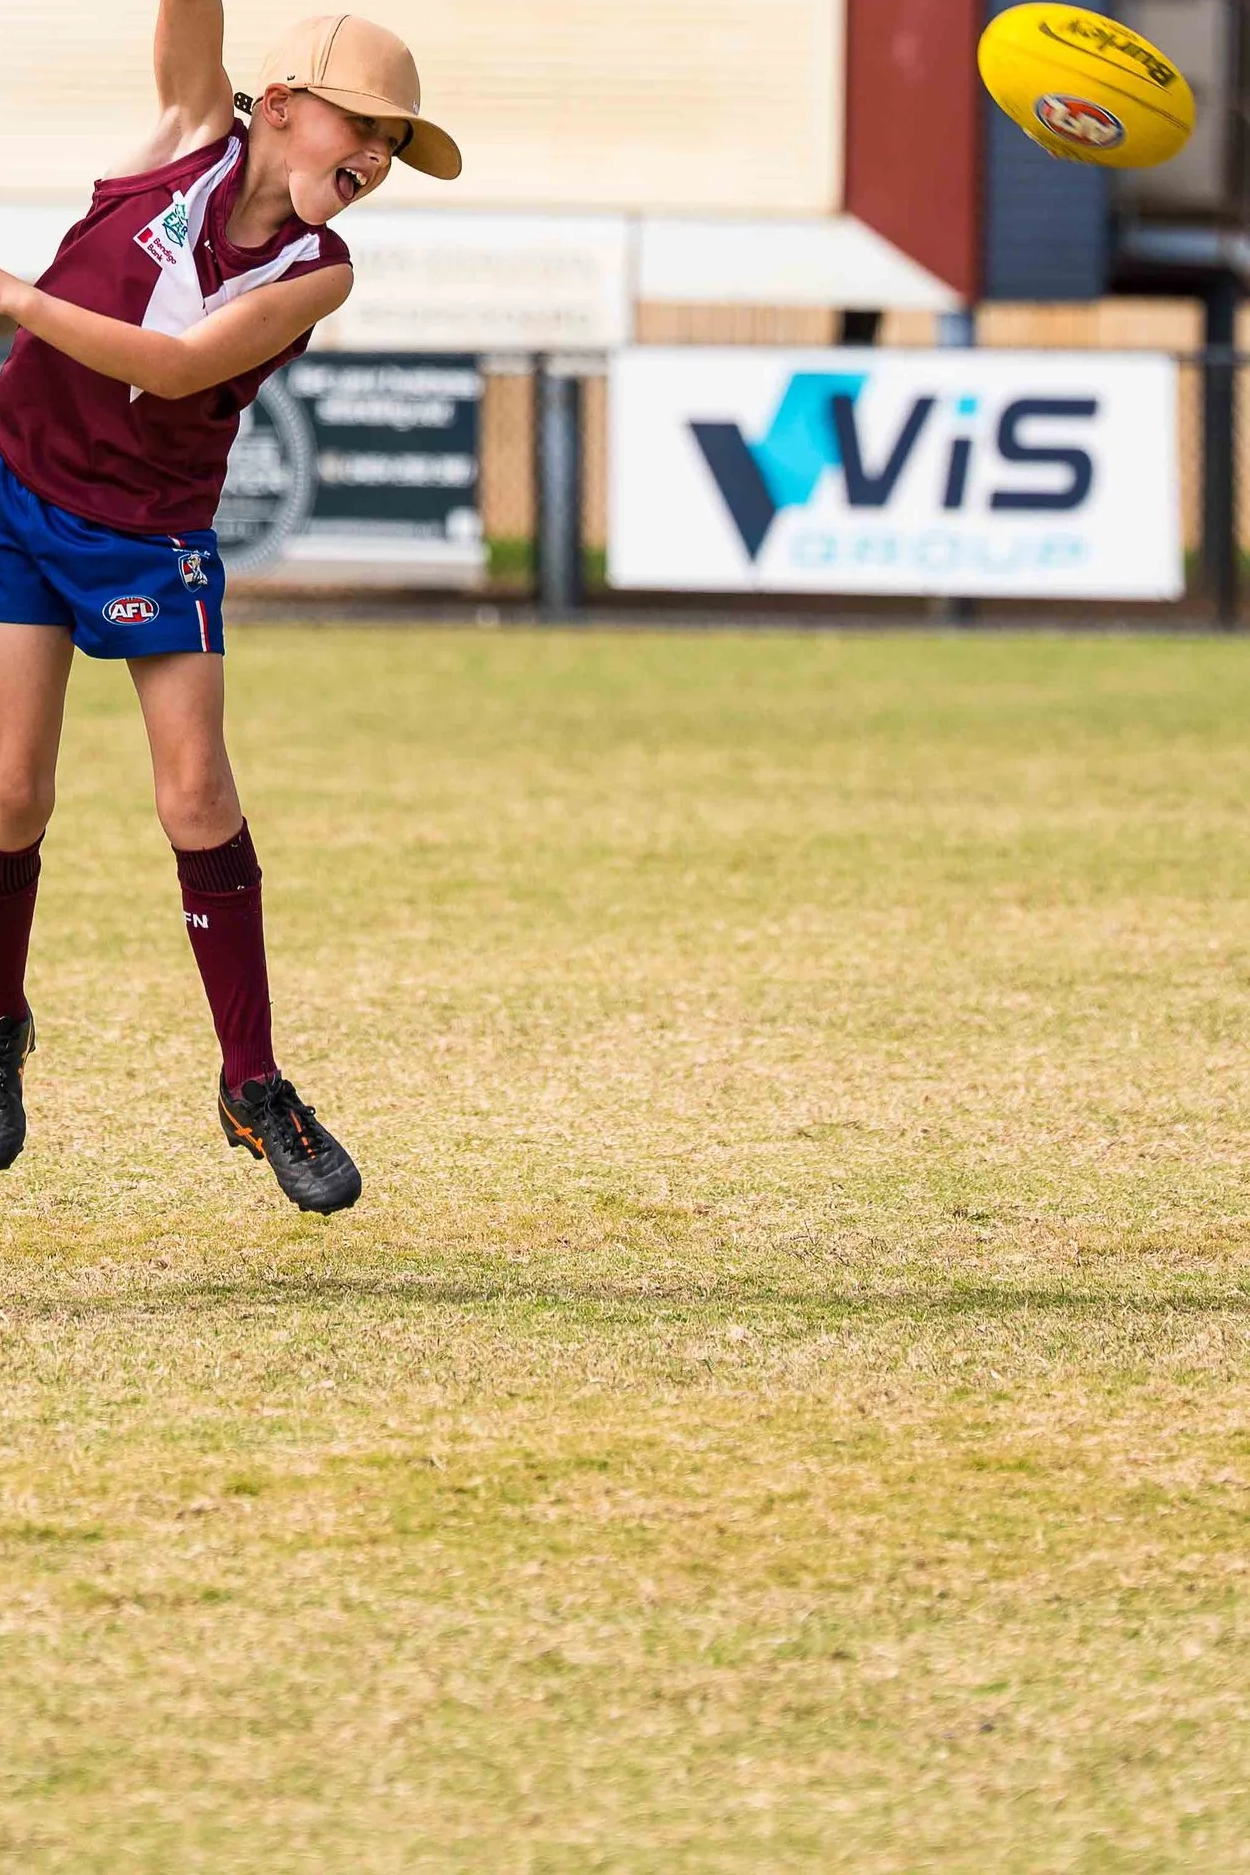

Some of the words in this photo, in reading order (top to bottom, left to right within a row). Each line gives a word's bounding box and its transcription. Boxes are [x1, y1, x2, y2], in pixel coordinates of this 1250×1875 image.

[147, 243, 163, 262] Bank
[153, 237, 177, 265] Bendigo
[110, 603, 154, 620] AFL
